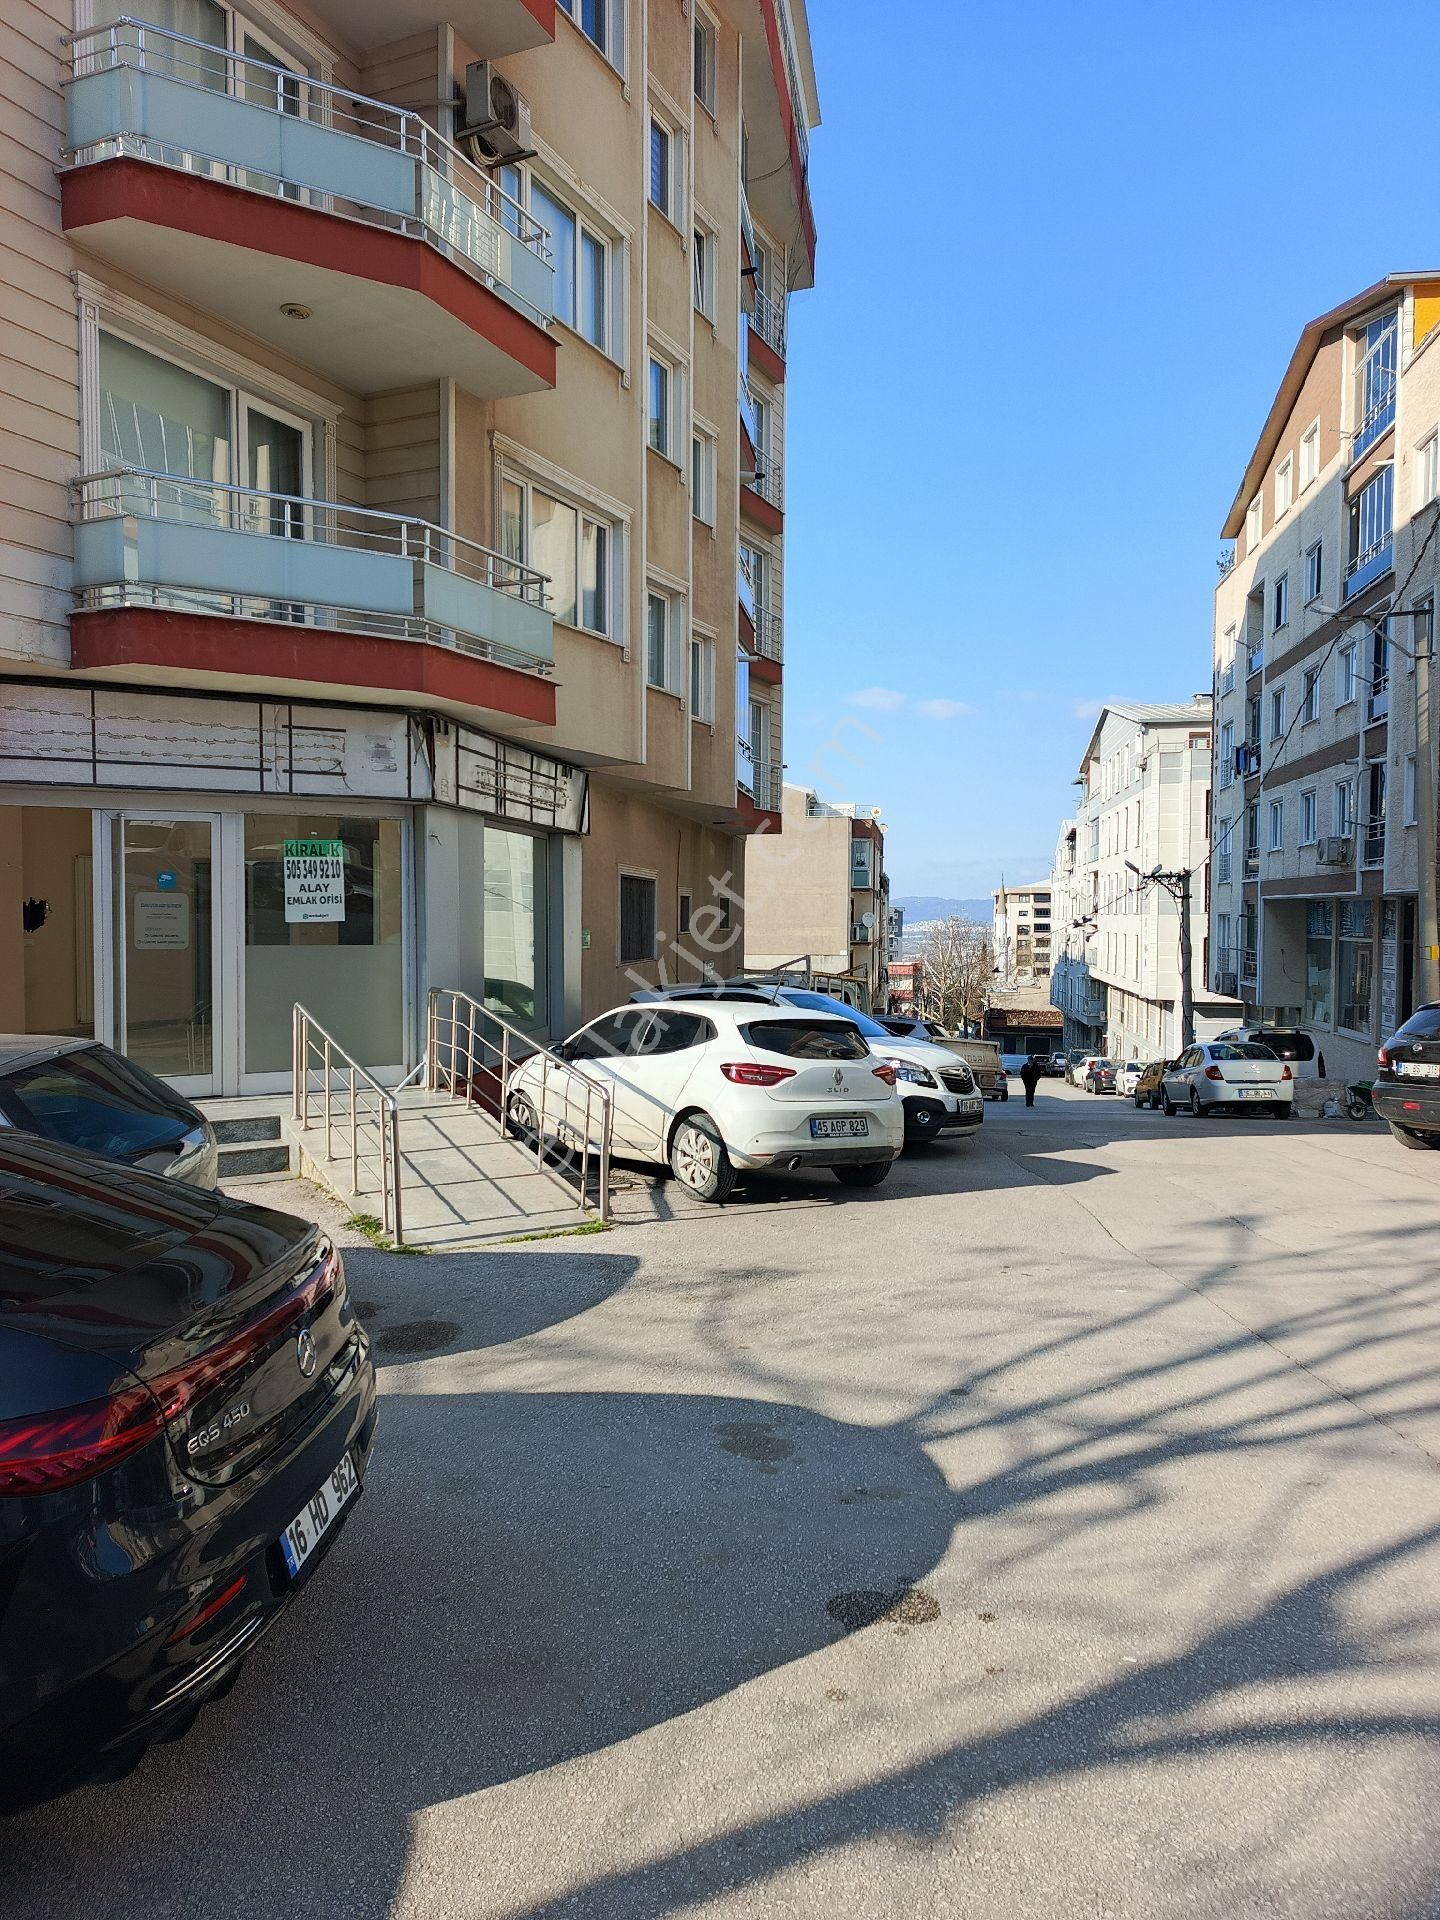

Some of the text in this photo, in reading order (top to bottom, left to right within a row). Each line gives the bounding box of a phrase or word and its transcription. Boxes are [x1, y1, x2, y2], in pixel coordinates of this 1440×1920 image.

[285, 841, 340, 857] KİRALIK
[286, 860, 301, 879] 505
[303, 860, 318, 879] 349
[298, 883, 330, 893] ALAY
[287, 894, 342, 905] EMLAK OFİSİ
[817, 1121, 829, 1133] 45
[831, 1121, 846, 1132] AGP
[849, 1120, 866, 1131] 829
[187, 1401, 250, 1455] EQS 450
[288, 1455, 357, 1561] 16 HD 962
